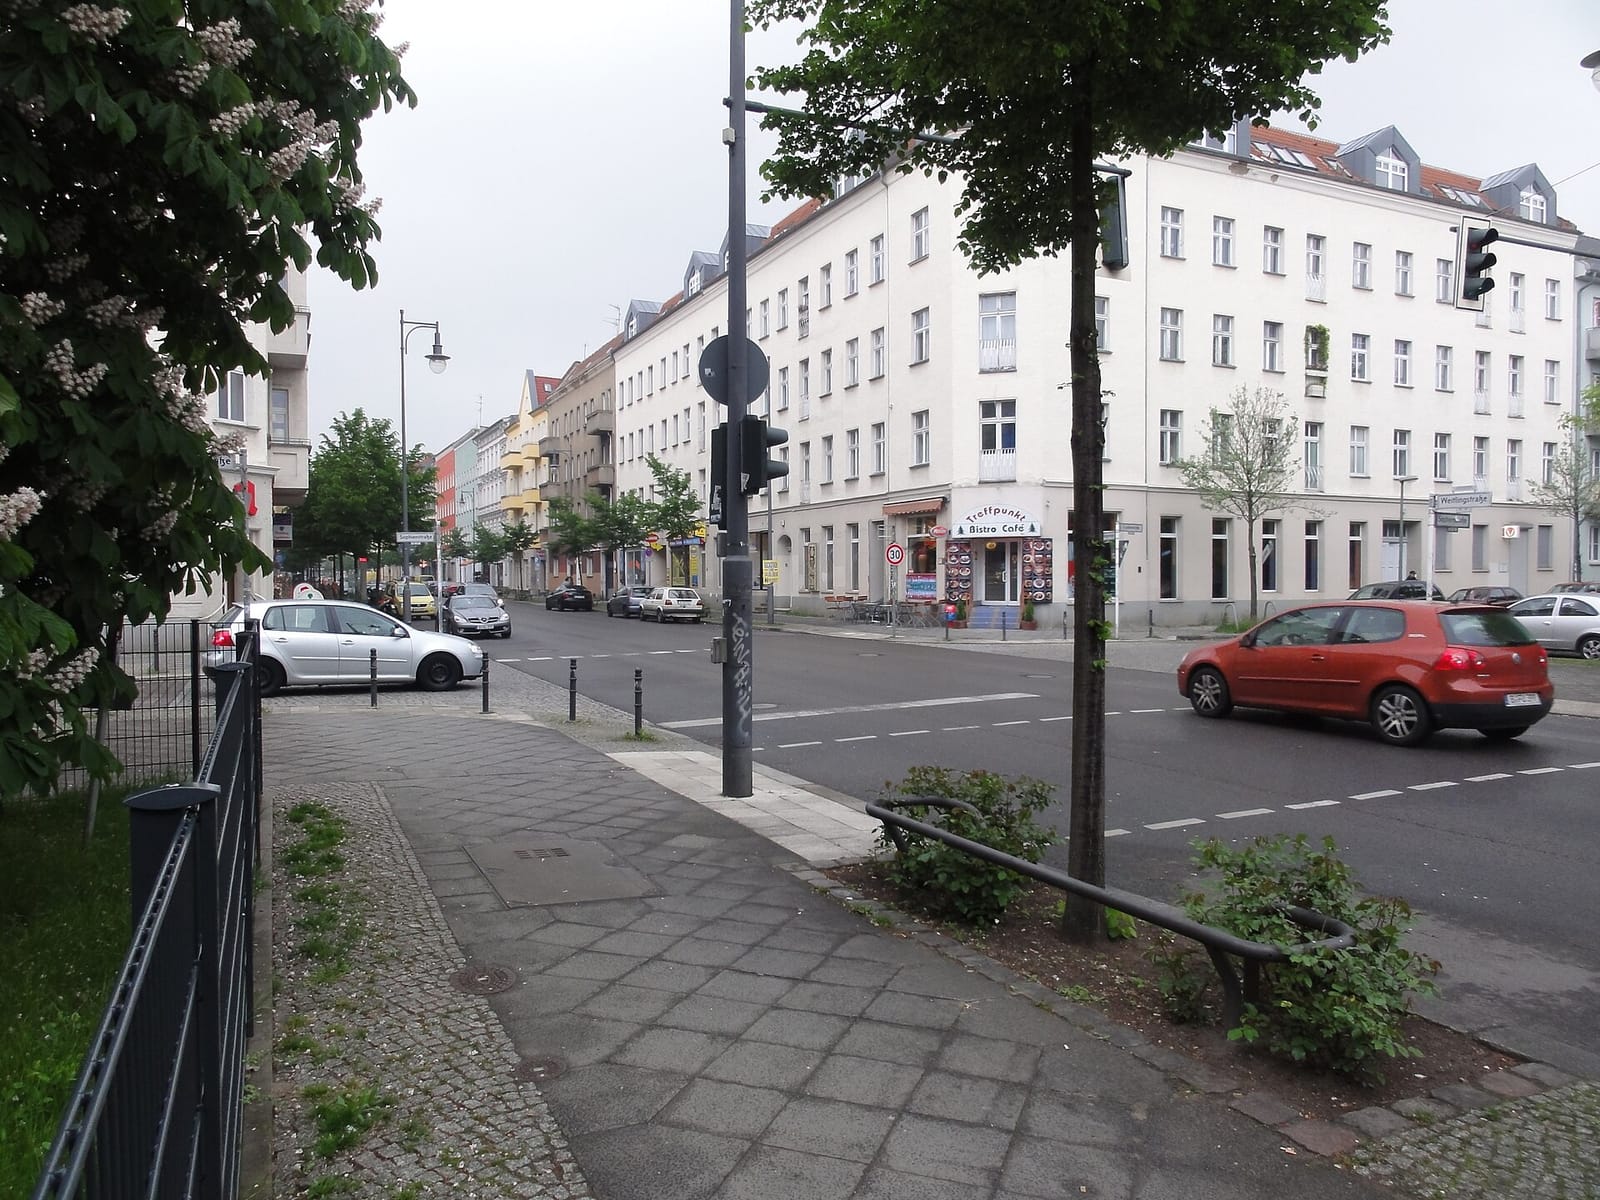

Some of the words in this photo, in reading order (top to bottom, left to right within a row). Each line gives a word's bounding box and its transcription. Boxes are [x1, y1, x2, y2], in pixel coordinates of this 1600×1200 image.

[966, 506, 1026, 523] Treffpunkt
[969, 526, 997, 534] Bistro
[1002, 524, 1025, 533] Café
[889, 549, 900, 560] 30
